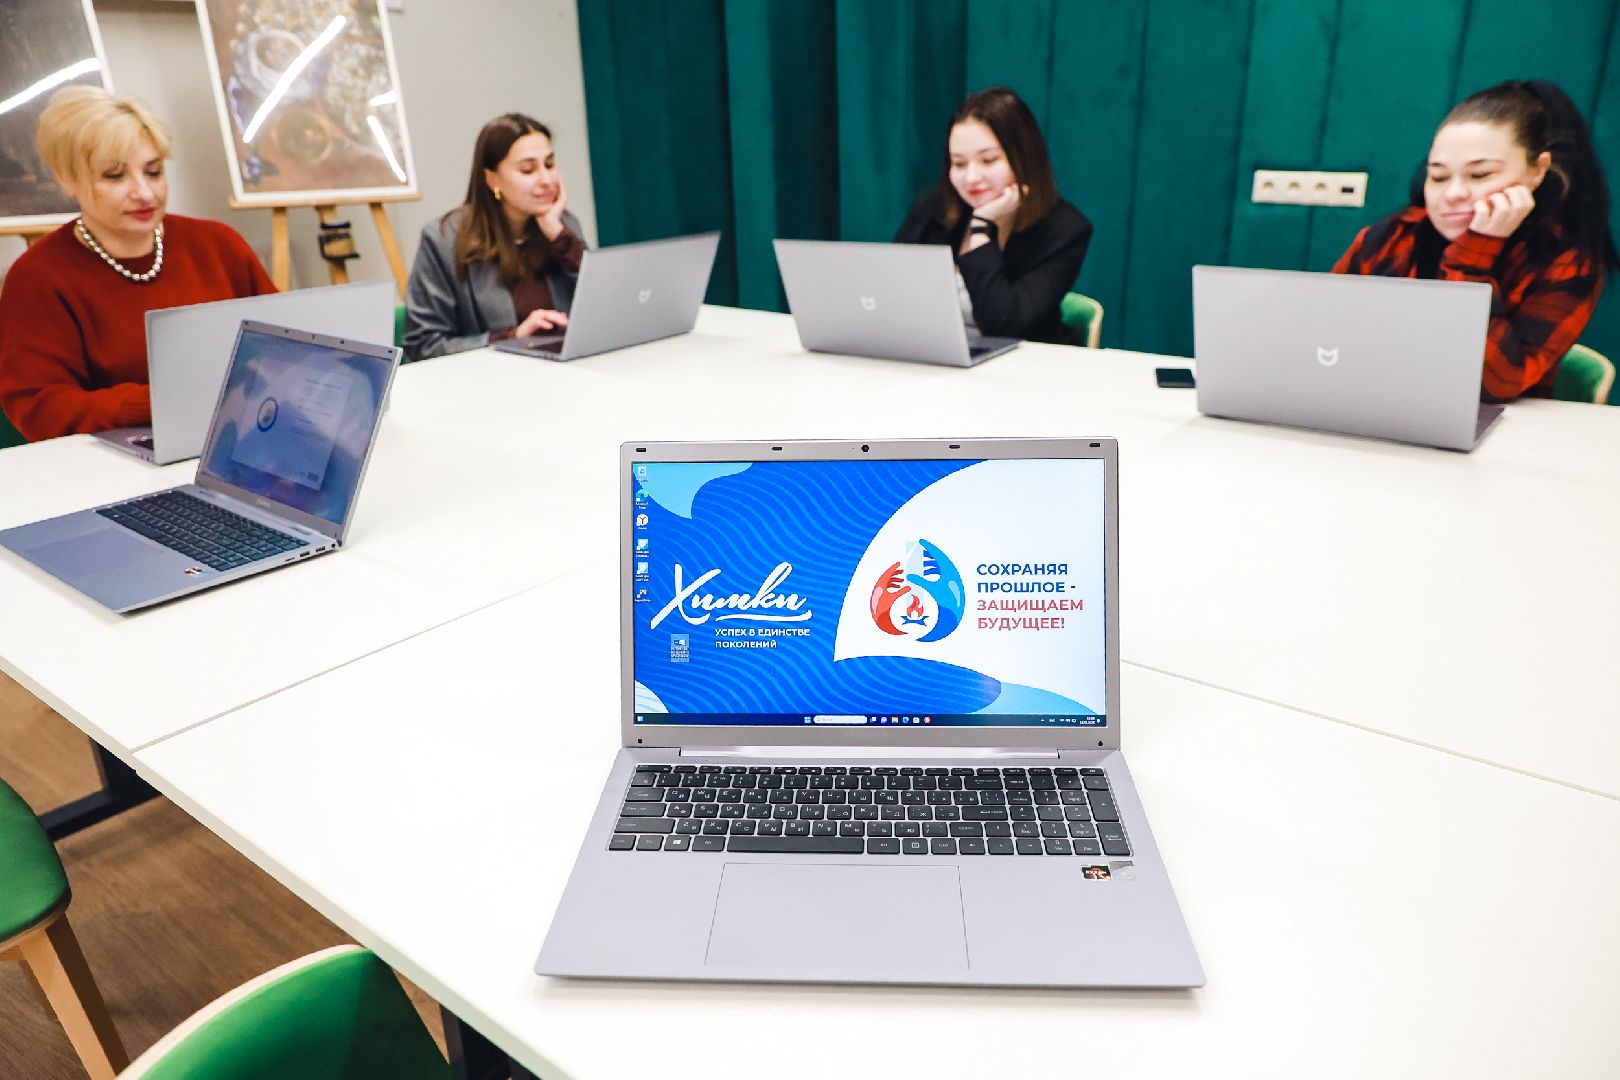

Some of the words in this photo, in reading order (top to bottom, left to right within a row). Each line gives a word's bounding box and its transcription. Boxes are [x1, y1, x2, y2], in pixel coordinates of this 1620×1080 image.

[976, 563, 1068, 576] СОХРАНЯЯ
[977, 581, 1066, 593] ПРОШЛОЕ
[650, 561, 808, 630] Химки
[976, 599, 1084, 613] ЗАЩИЩАЕМ
[977, 617, 1065, 631] БУДУЩЕЕ!
[715, 628, 746, 637] УСПЕХ
[749, 628, 755, 637] В
[758, 628, 811, 638] ЕДИНСТВЕ
[715, 640, 777, 649] ПОКОЛЕНИЙ
